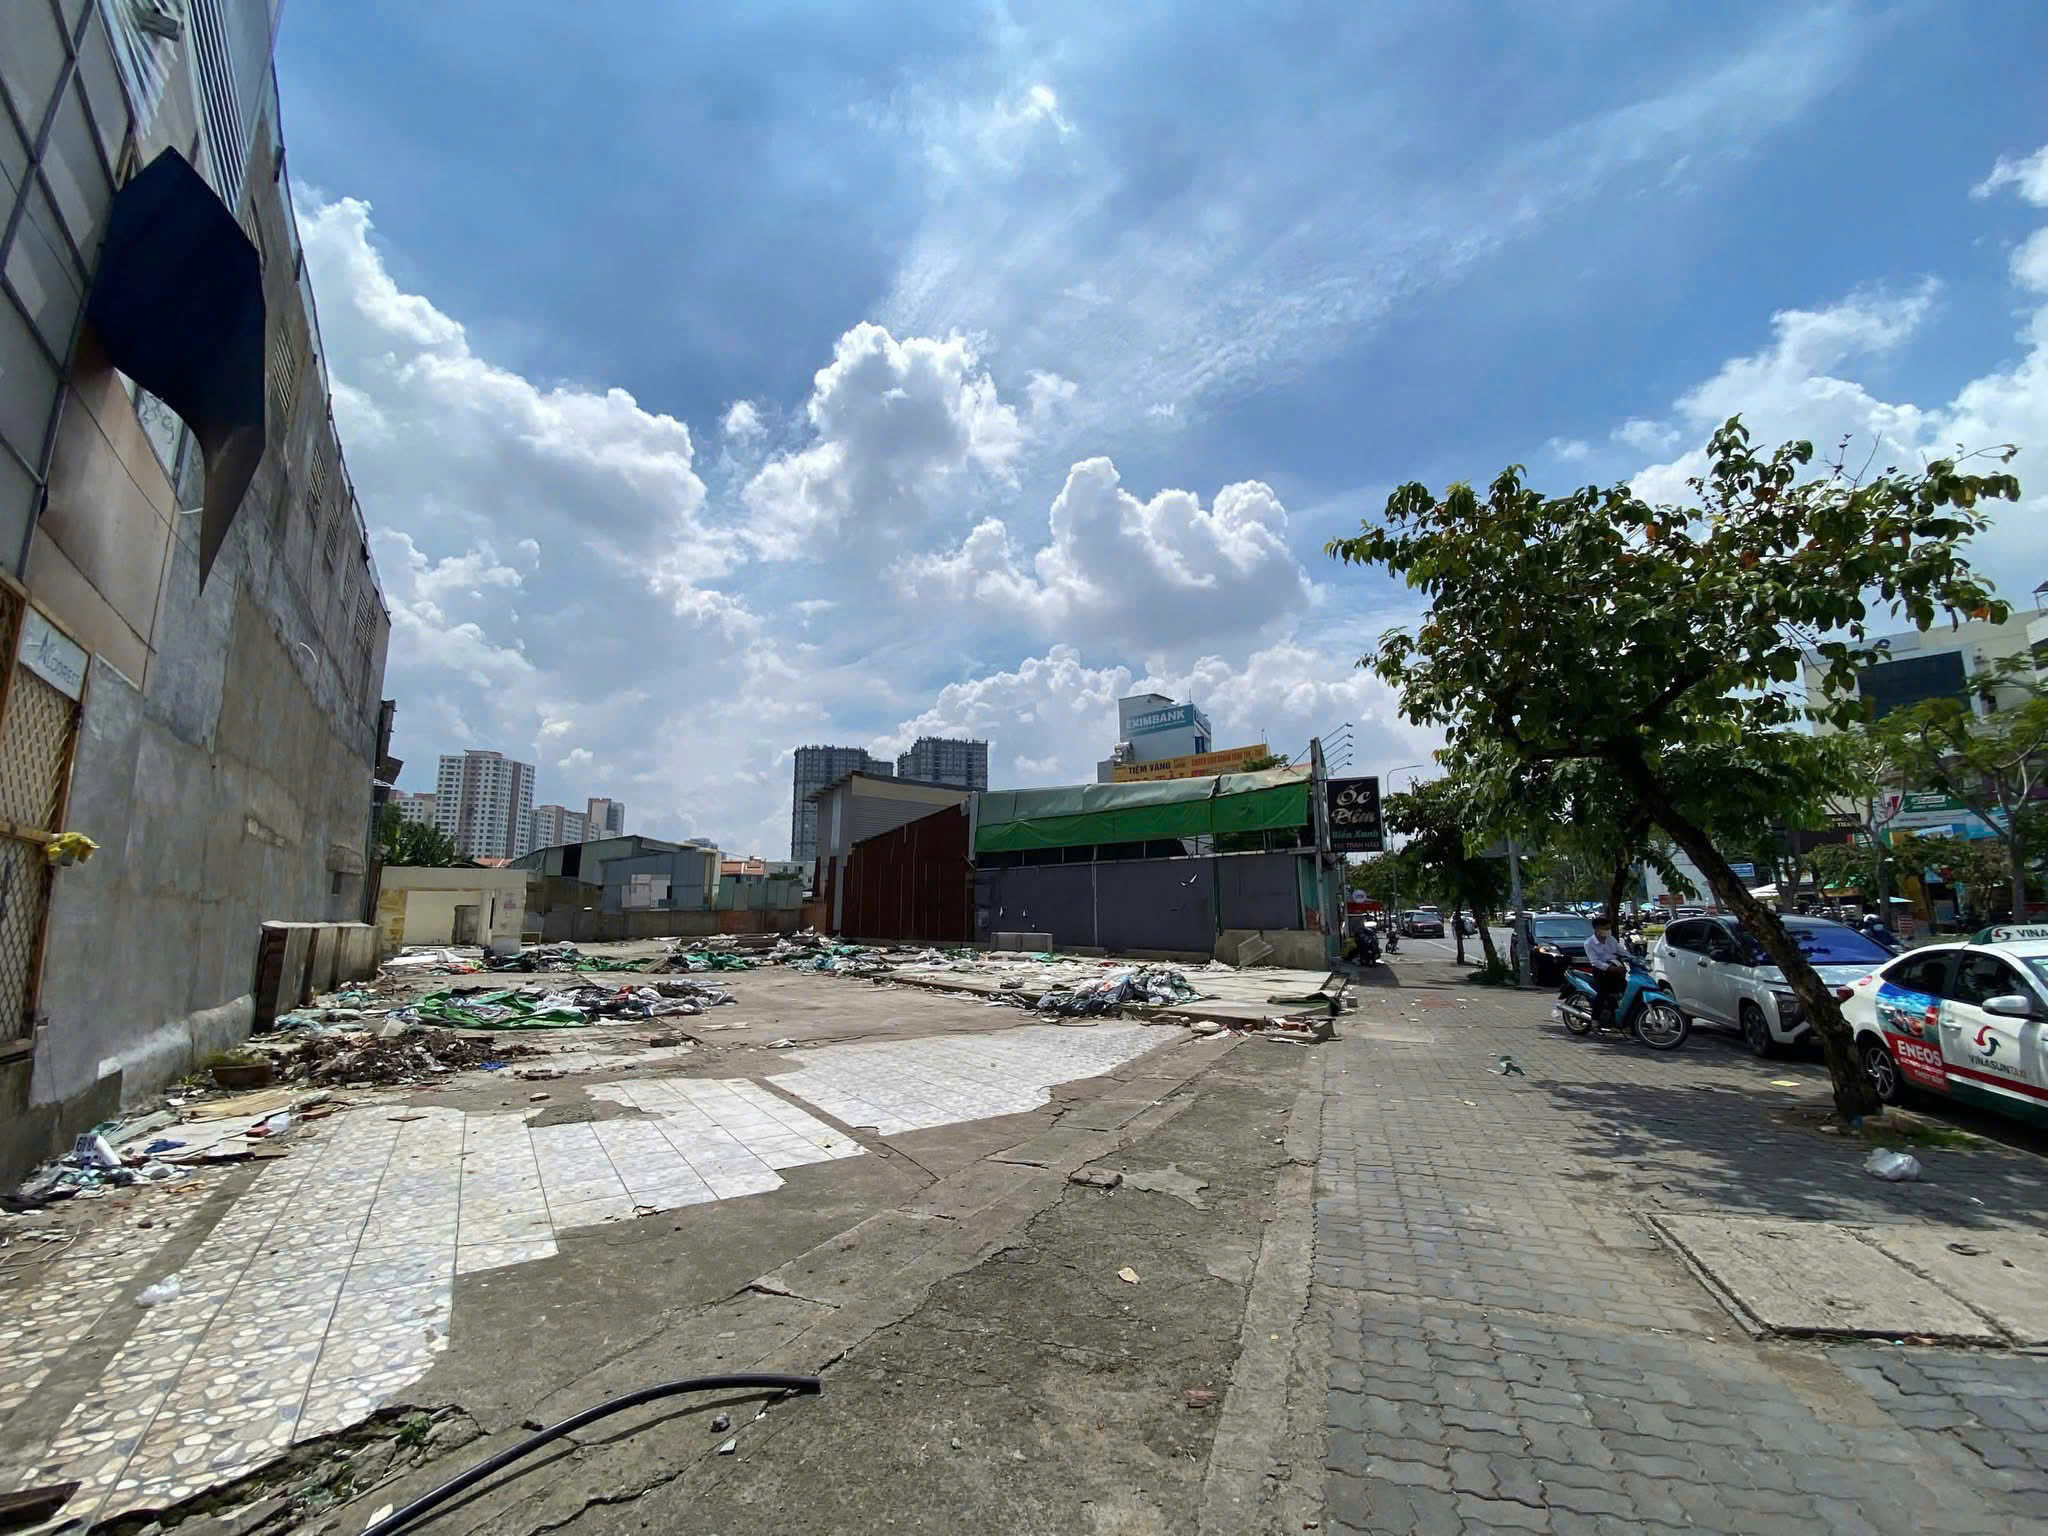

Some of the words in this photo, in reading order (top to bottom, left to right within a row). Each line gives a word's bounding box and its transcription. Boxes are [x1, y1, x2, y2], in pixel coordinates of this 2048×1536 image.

[1127, 710, 1185, 728] EXIMBANK
[1336, 783, 1371, 806] Ốc
[1897, 1040, 1943, 1067] ENEOS
